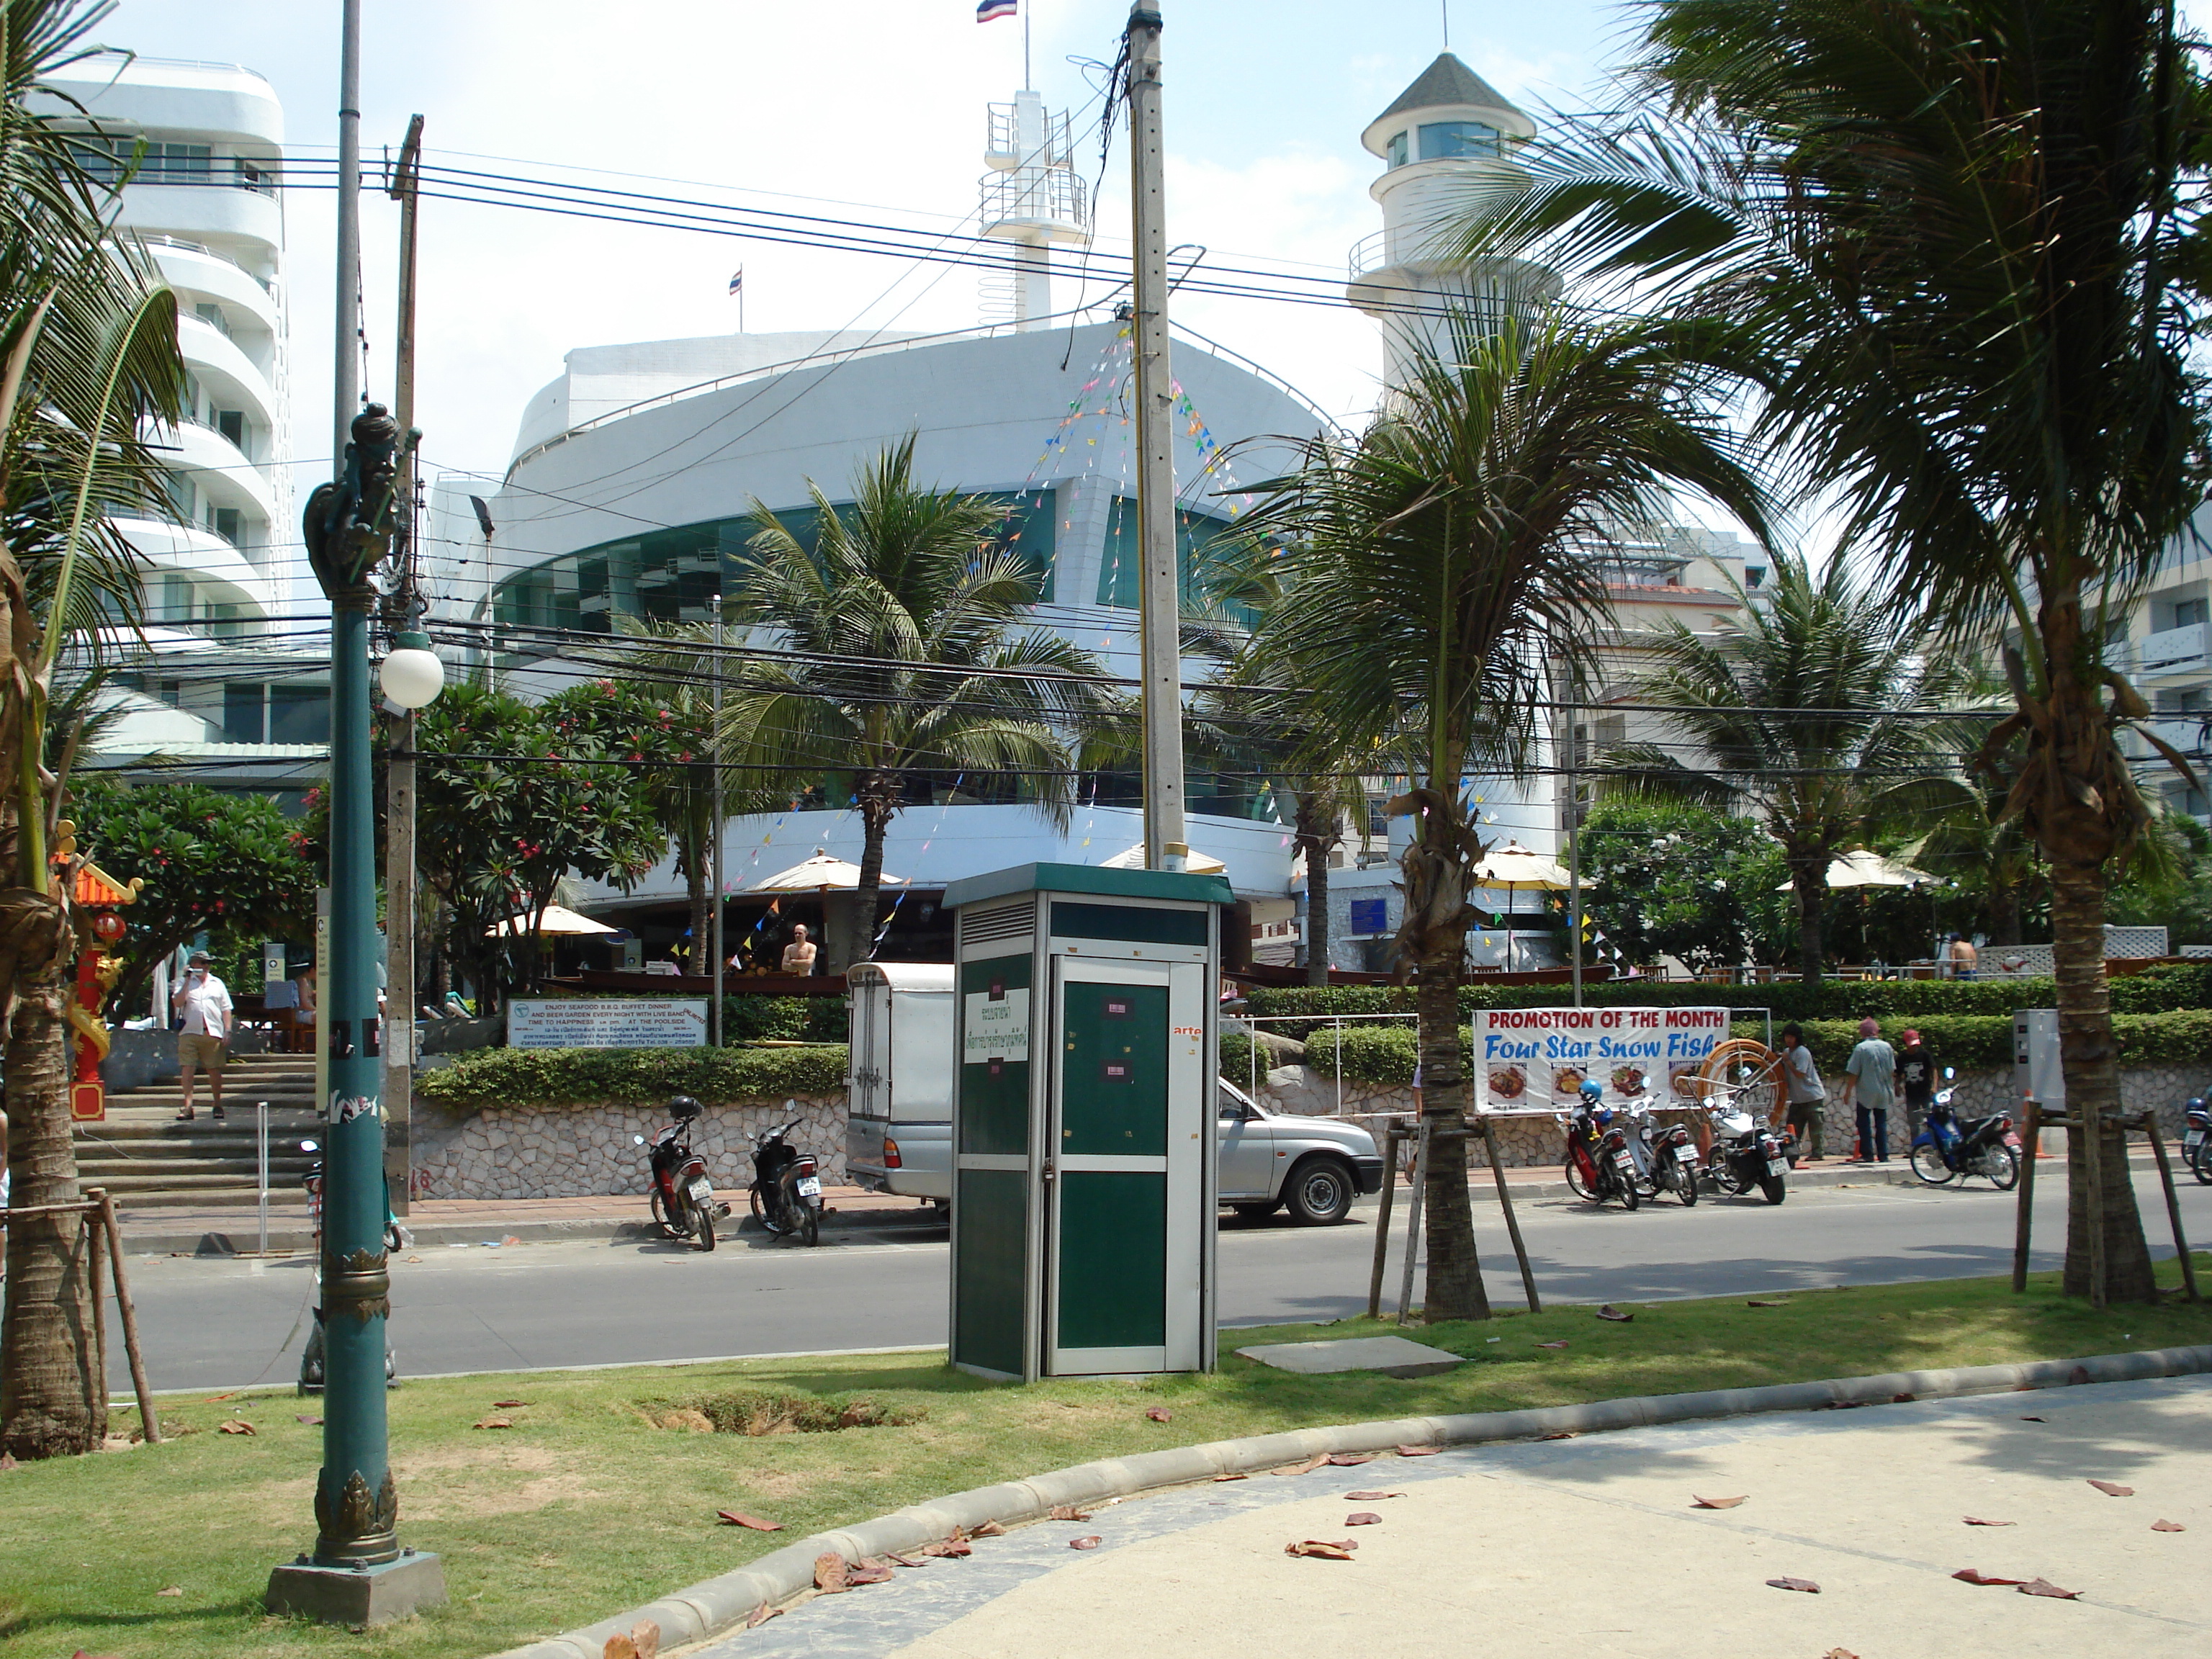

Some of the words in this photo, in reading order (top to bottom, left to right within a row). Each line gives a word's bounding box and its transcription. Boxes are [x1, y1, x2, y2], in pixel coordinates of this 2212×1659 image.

[1489, 1012, 1594, 1029] PROMOTION
[1600, 1011, 1622, 1028] OF
[1629, 1011, 1659, 1028] THE
[1665, 1011, 1725, 1028] MONTH
[1485, 1034, 1539, 1059] Four
[1546, 1035, 1593, 1058] Star
[1599, 1035, 1661, 1058] Snow
[1667, 1033, 1714, 1058] Fish
